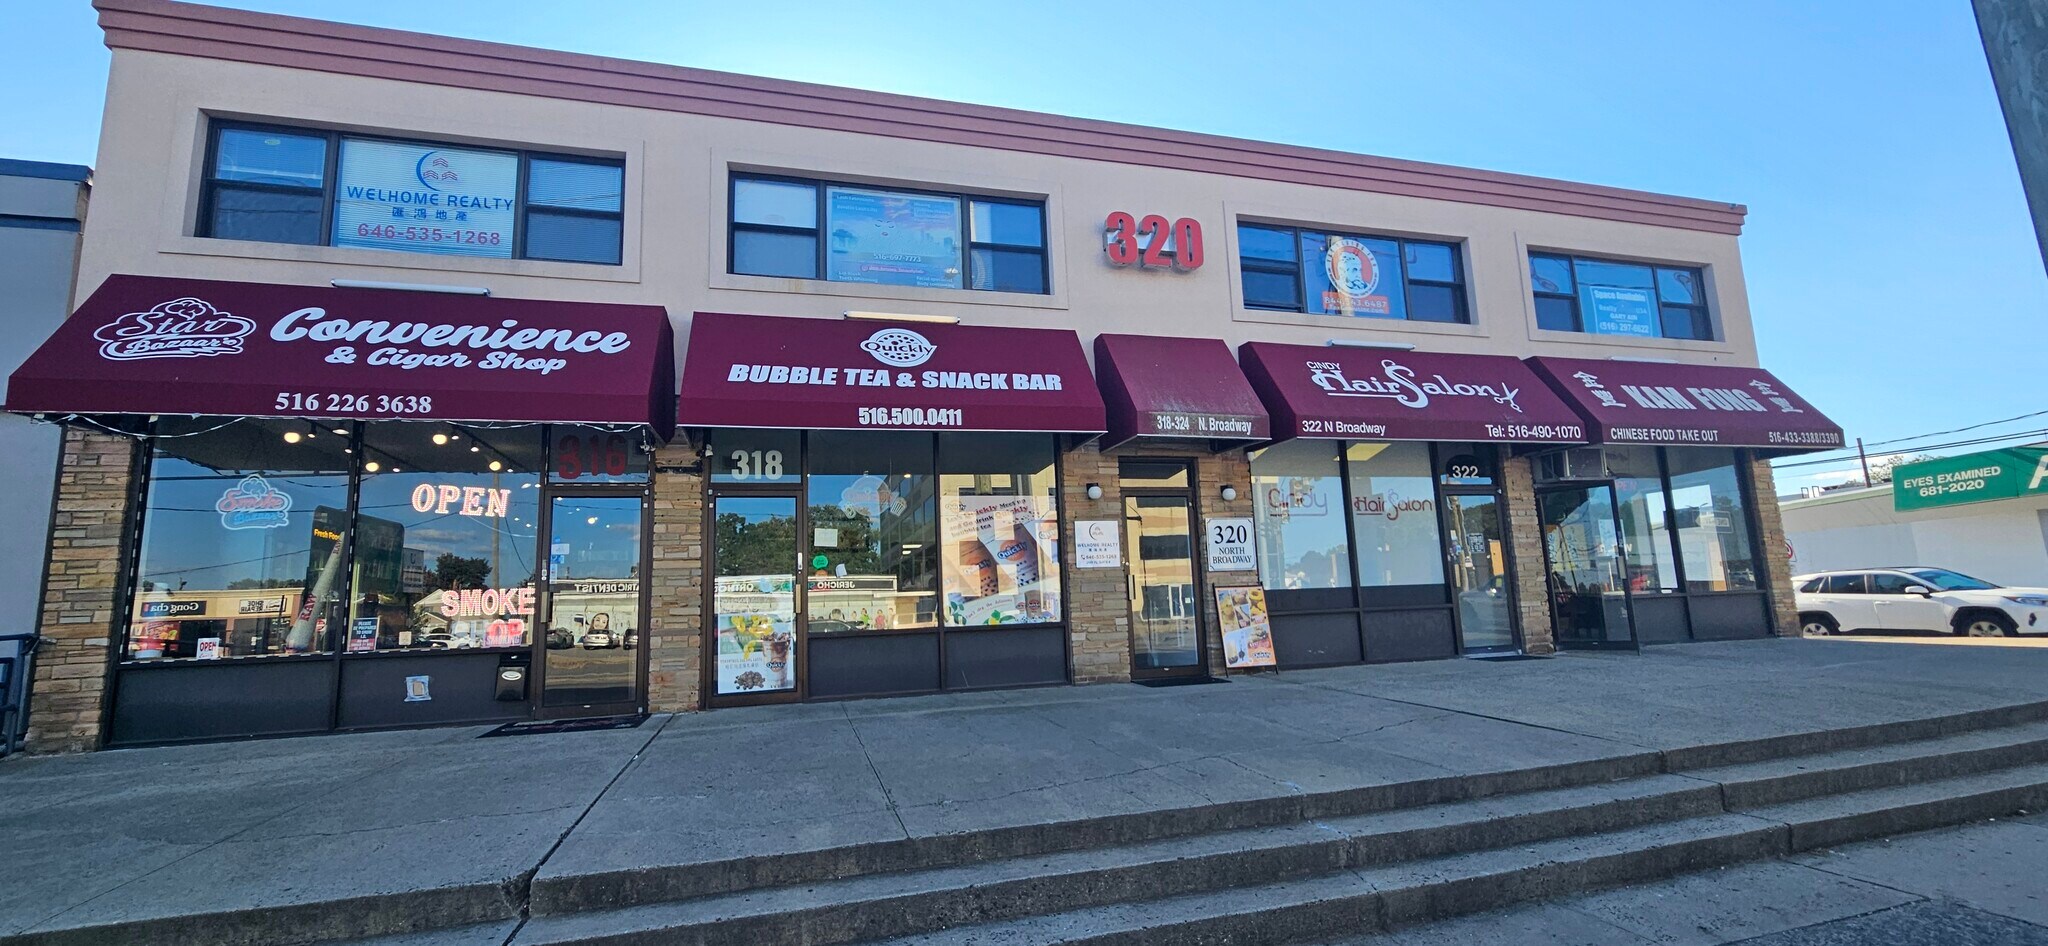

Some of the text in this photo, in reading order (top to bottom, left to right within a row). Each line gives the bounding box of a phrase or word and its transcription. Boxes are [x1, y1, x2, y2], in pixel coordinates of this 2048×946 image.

[347, 186, 513, 211] WELHOME REALTY
[358, 223, 500, 245] 646-535-1268
[1103, 210, 1204, 270] 320
[116, 312, 228, 336] Star
[270, 307, 632, 354] Convenience
[864, 339, 937, 355] Quickly
[324, 346, 567, 375] & Cigar Shop
[1306, 360, 1341, 370] CINDY
[727, 364, 1063, 391] BUBBLE TEA & SNACK BAR
[1311, 359, 1500, 409] Hair Salon
[274, 392, 432, 413] 516 226 3638
[1620, 384, 1768, 413] KAM FONG
[858, 407, 962, 426] 516.500.0411
[1157, 415, 1252, 436] 318-324 N. Broadway
[1302, 420, 1386, 436] 322 N Broadway
[1485, 424, 1581, 439] Tel: 516-490-1070
[1611, 427, 1719, 442] CHINESE FOOD TAKE OUT
[1768, 431, 1840, 444] 516-433-3388/3390
[558, 434, 627, 480] 316
[731, 450, 783, 480] 318
[1452, 466, 1479, 479] 322
[1904, 466, 2001, 489] EYES EXAMINED
[1919, 479, 1985, 497] 681-2020
[411, 484, 511, 517] OPEN
[1268, 488, 1328, 515] Cindy
[1354, 489, 1433, 521] Hair Salon
[974, 515, 994, 524] drink
[314, 529, 328, 539] Fresh
[1214, 525, 1247, 544] 320
[997, 541, 1028, 560] Quickly
[1212, 555, 1251, 564] BROADWAY
[440, 588, 535, 617] SMOKE
[200, 641, 217, 652] OPEN
